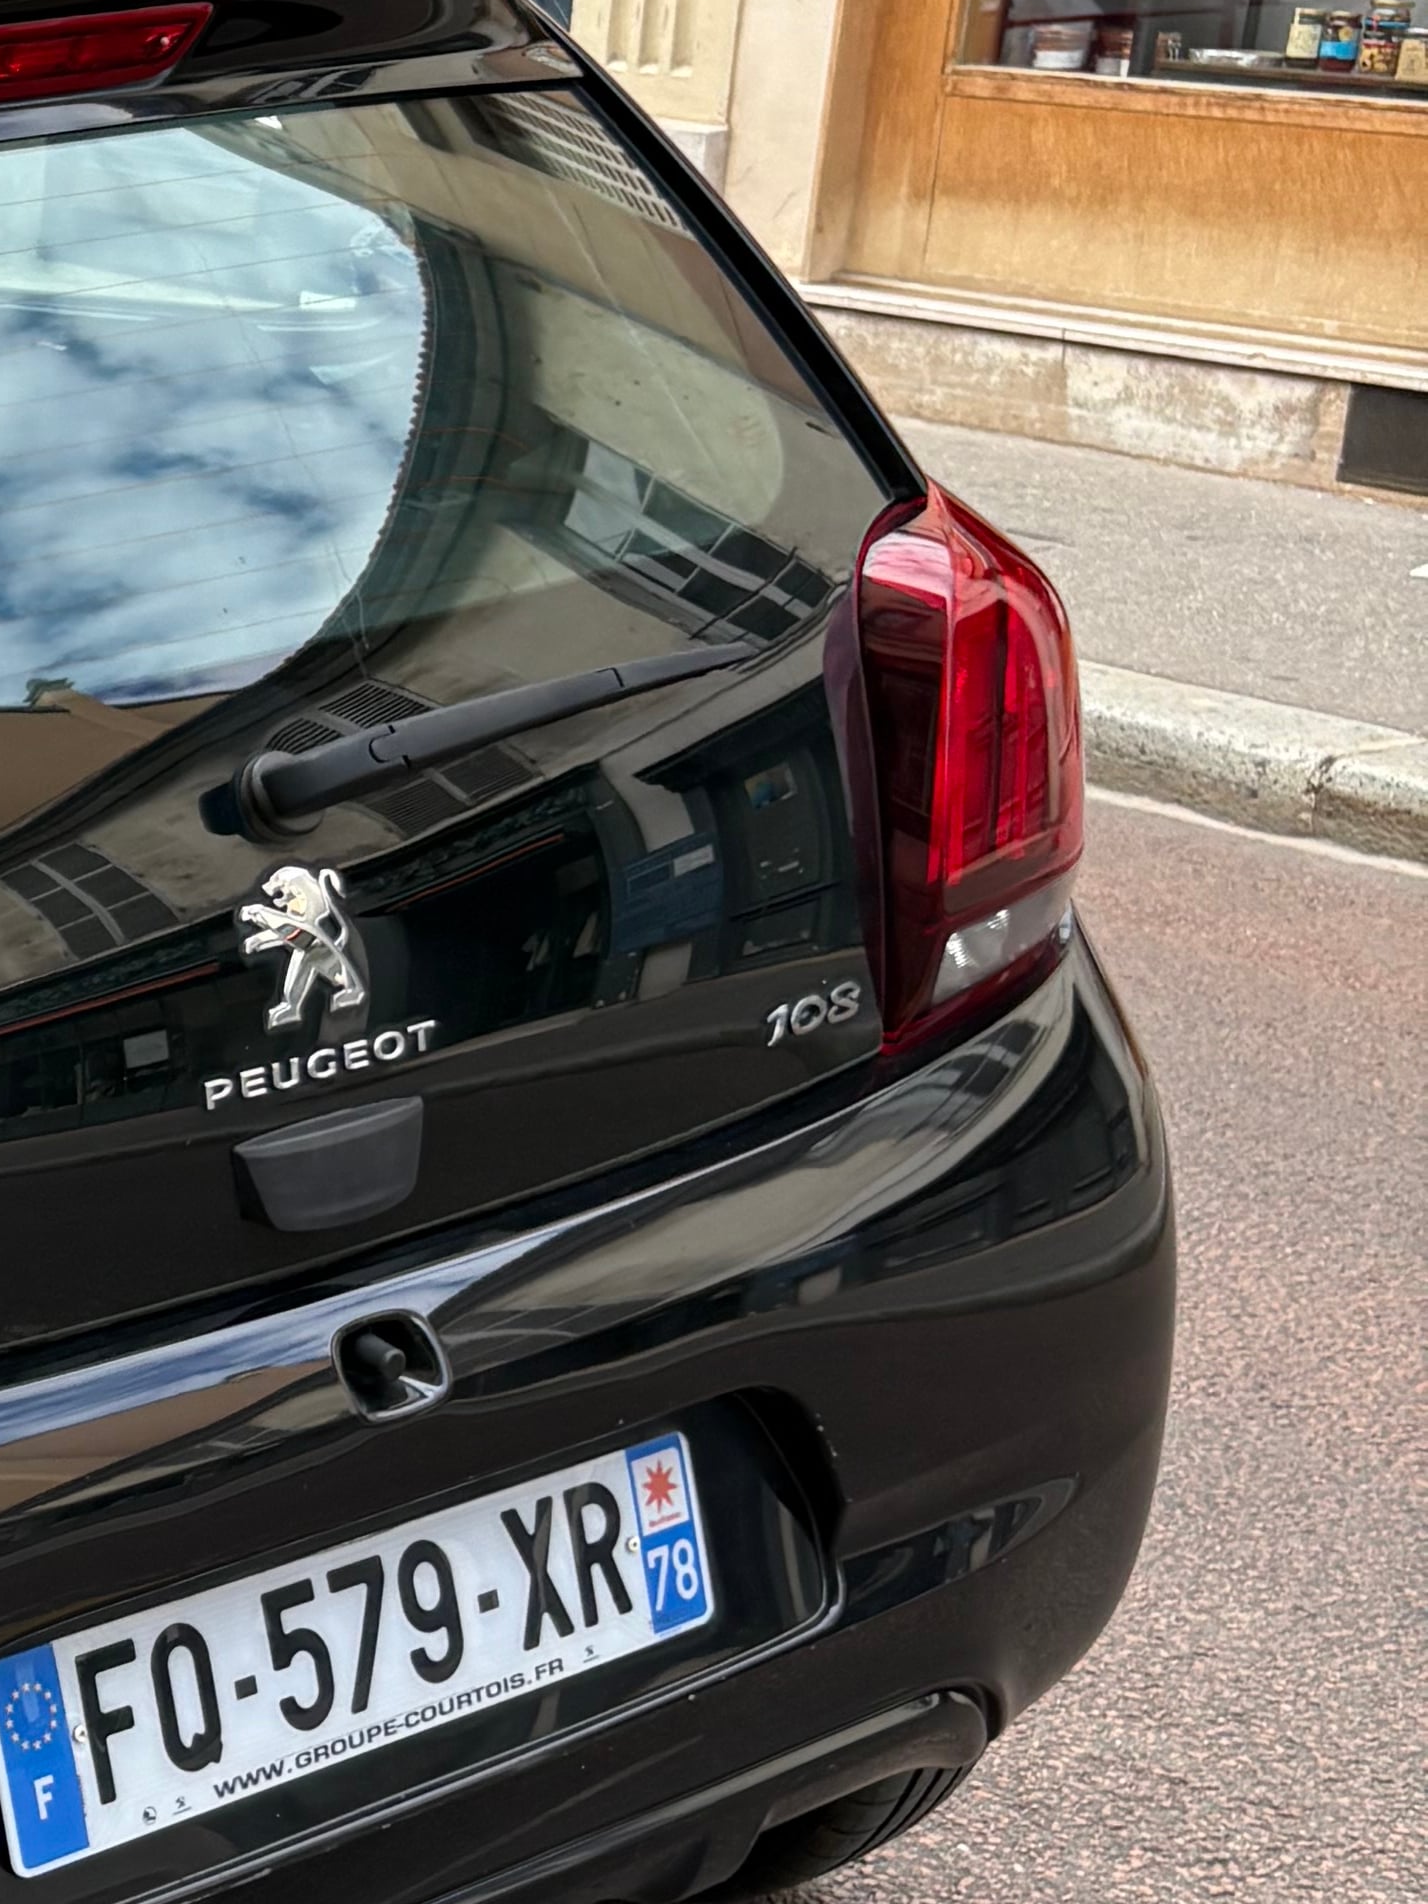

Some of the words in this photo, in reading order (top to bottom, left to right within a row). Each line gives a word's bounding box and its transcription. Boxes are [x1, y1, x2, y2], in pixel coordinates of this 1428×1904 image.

[764, 981, 862, 1048] 108
[204, 1019, 437, 1111] PEUGEOT
[647, 1538, 699, 1612] 78
[74, 1480, 634, 1806] FQ-579-XR
[212, 1657, 565, 1799] WWW.GROUPE-COURTOIS.FR
[33, 1774, 55, 1821] F
